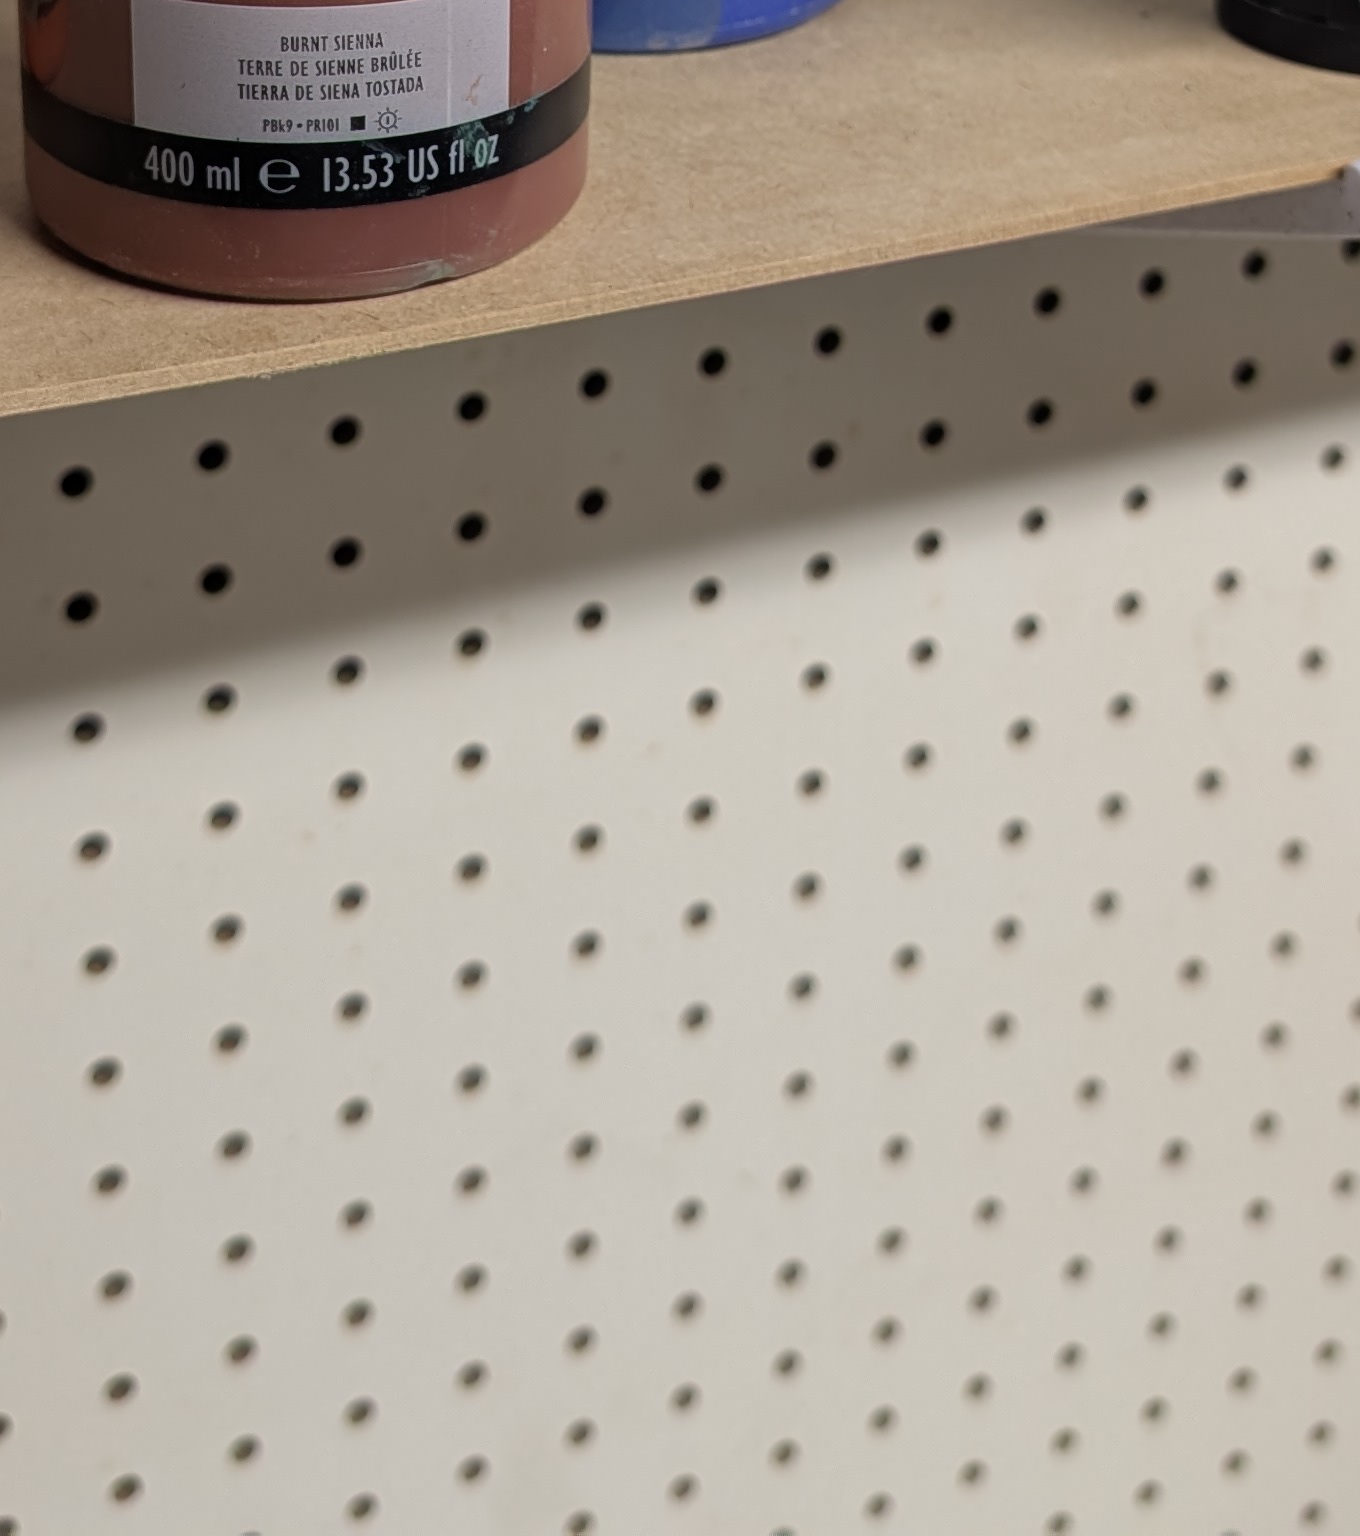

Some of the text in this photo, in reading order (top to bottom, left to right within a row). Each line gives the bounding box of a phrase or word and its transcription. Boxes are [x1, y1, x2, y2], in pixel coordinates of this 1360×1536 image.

[280, 32, 384, 52] BURNT SIENNA
[237, 48, 422, 77] TERRE DE SIENNE BRÛLÉE
[237, 76, 424, 101] TIERRA DE SIENA TOSTADA
[262, 118, 293, 133] PBk9
[143, 145, 195, 186] 400
[206, 156, 240, 192] ml
[322, 154, 395, 193] 13.53
[408, 144, 439, 183] US
[448, 138, 465, 176] fl
